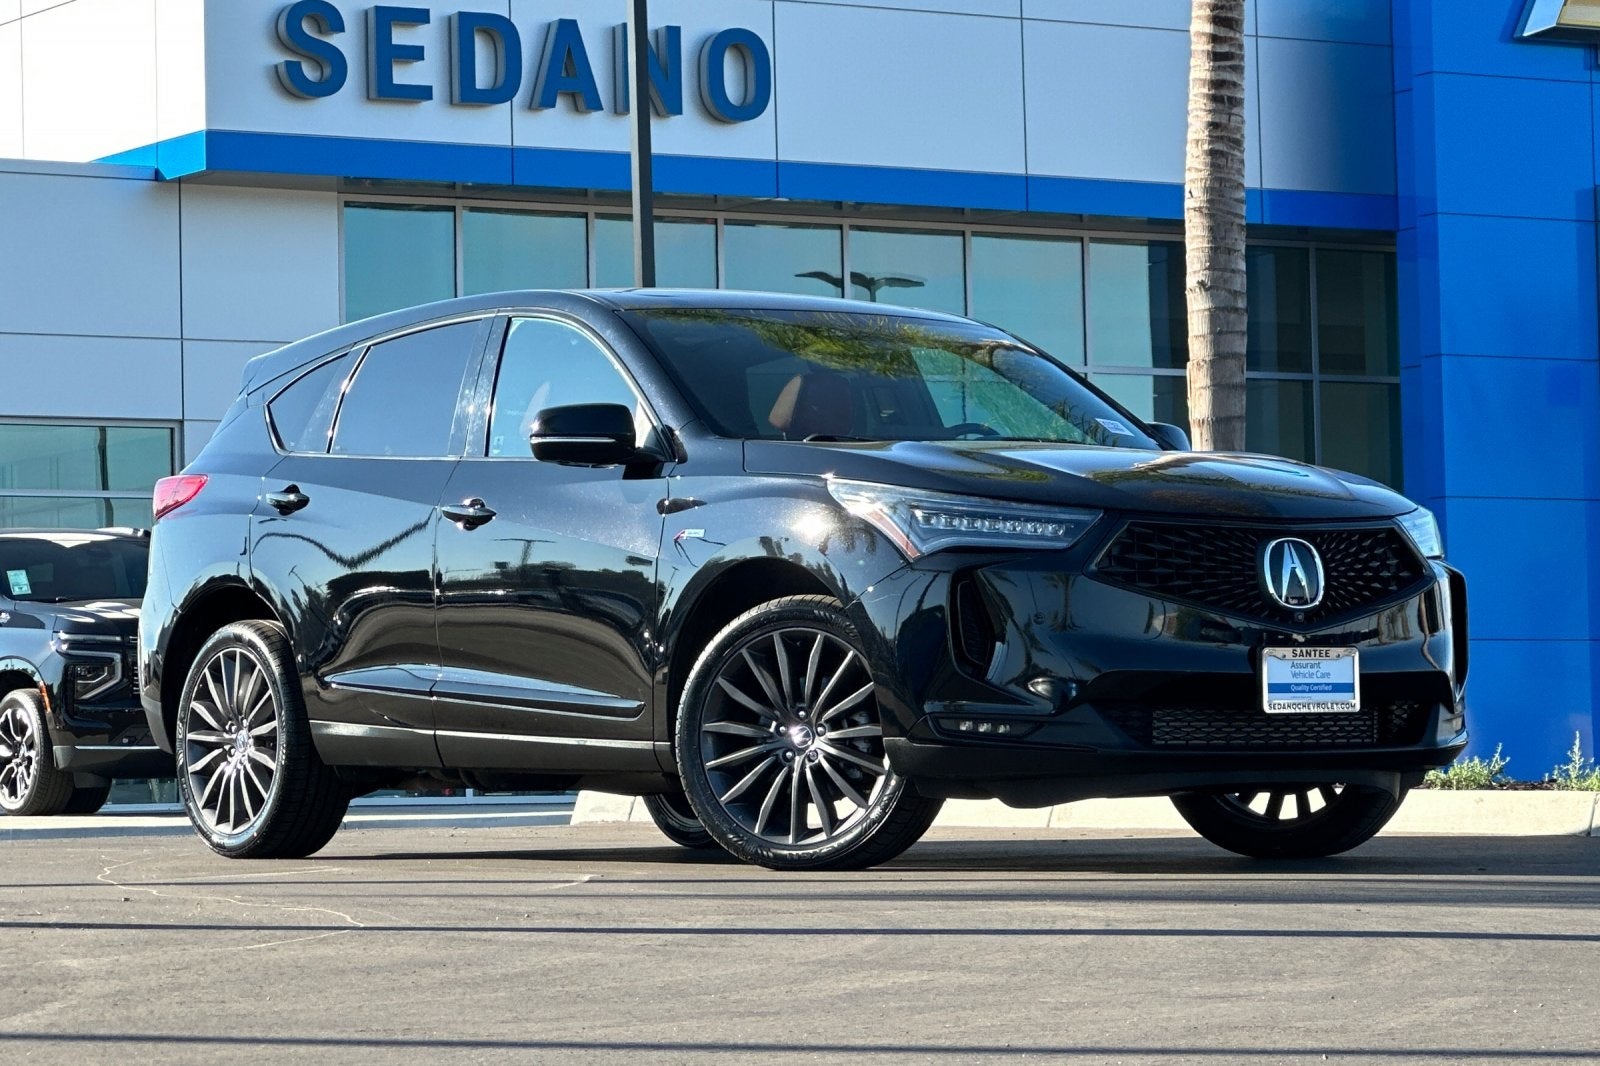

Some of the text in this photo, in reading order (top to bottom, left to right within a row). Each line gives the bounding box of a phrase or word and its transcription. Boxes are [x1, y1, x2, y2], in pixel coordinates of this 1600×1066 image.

[276, 0, 772, 123] SEDANO
[1292, 649, 1331, 658] SANTEE
[1290, 661, 1321, 669] Assurant
[1291, 670, 1331, 678] Vehicle Care
[1290, 684, 1309, 692] Quality
[1268, 702, 1356, 711] SEDANOCHEVROLET.COM
